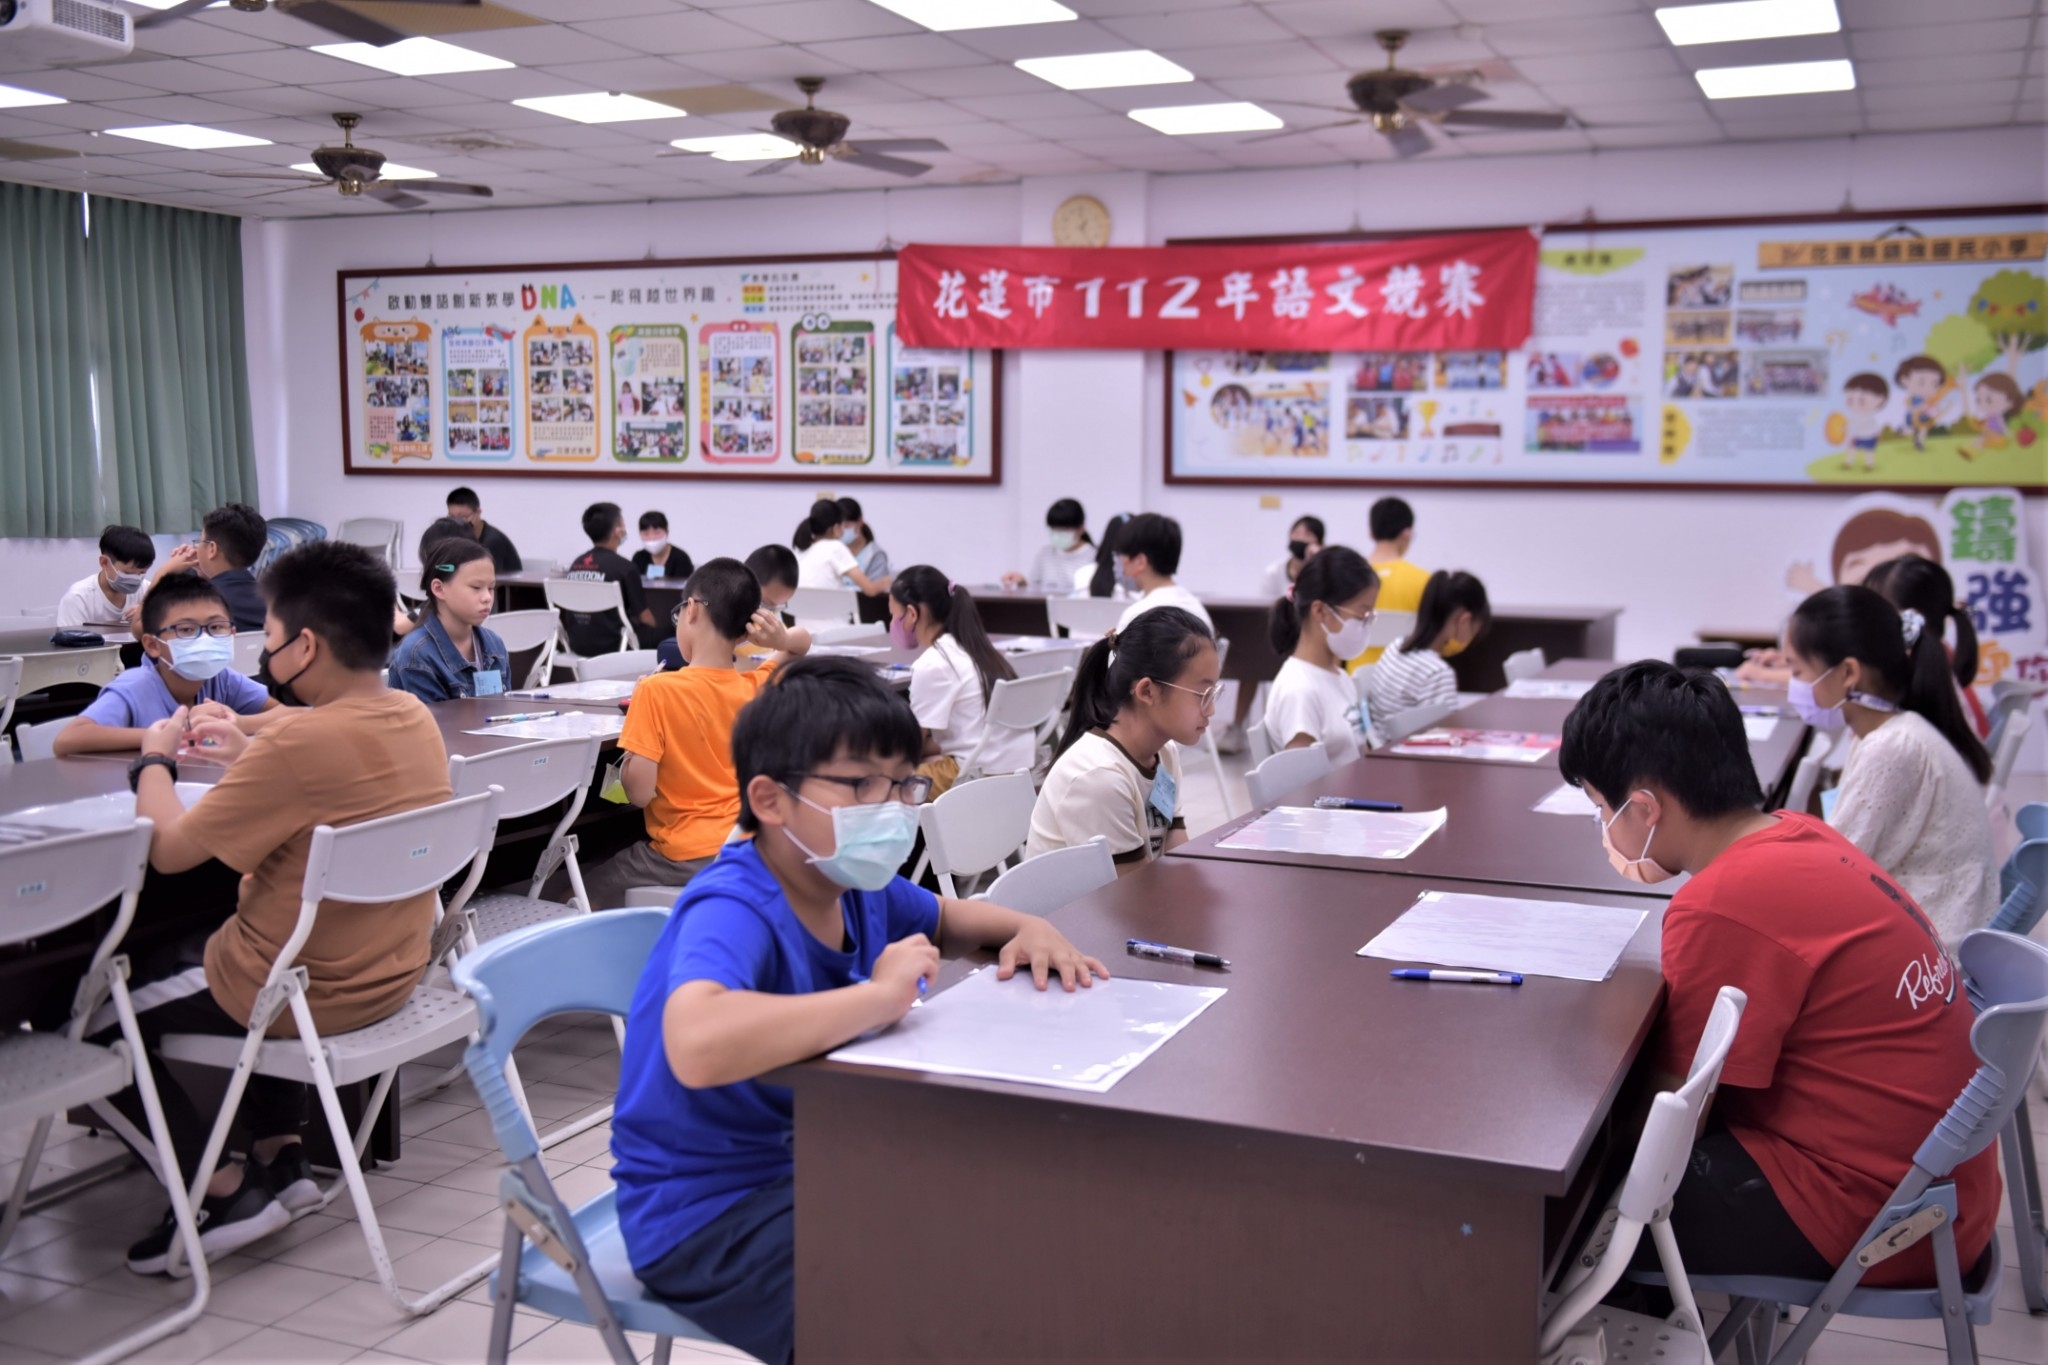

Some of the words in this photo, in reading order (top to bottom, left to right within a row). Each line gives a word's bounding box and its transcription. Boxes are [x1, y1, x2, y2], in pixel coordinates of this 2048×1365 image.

[521, 283, 577, 311] DNA
[933, 259, 1487, 320] 花蓮市112年語文競賽
